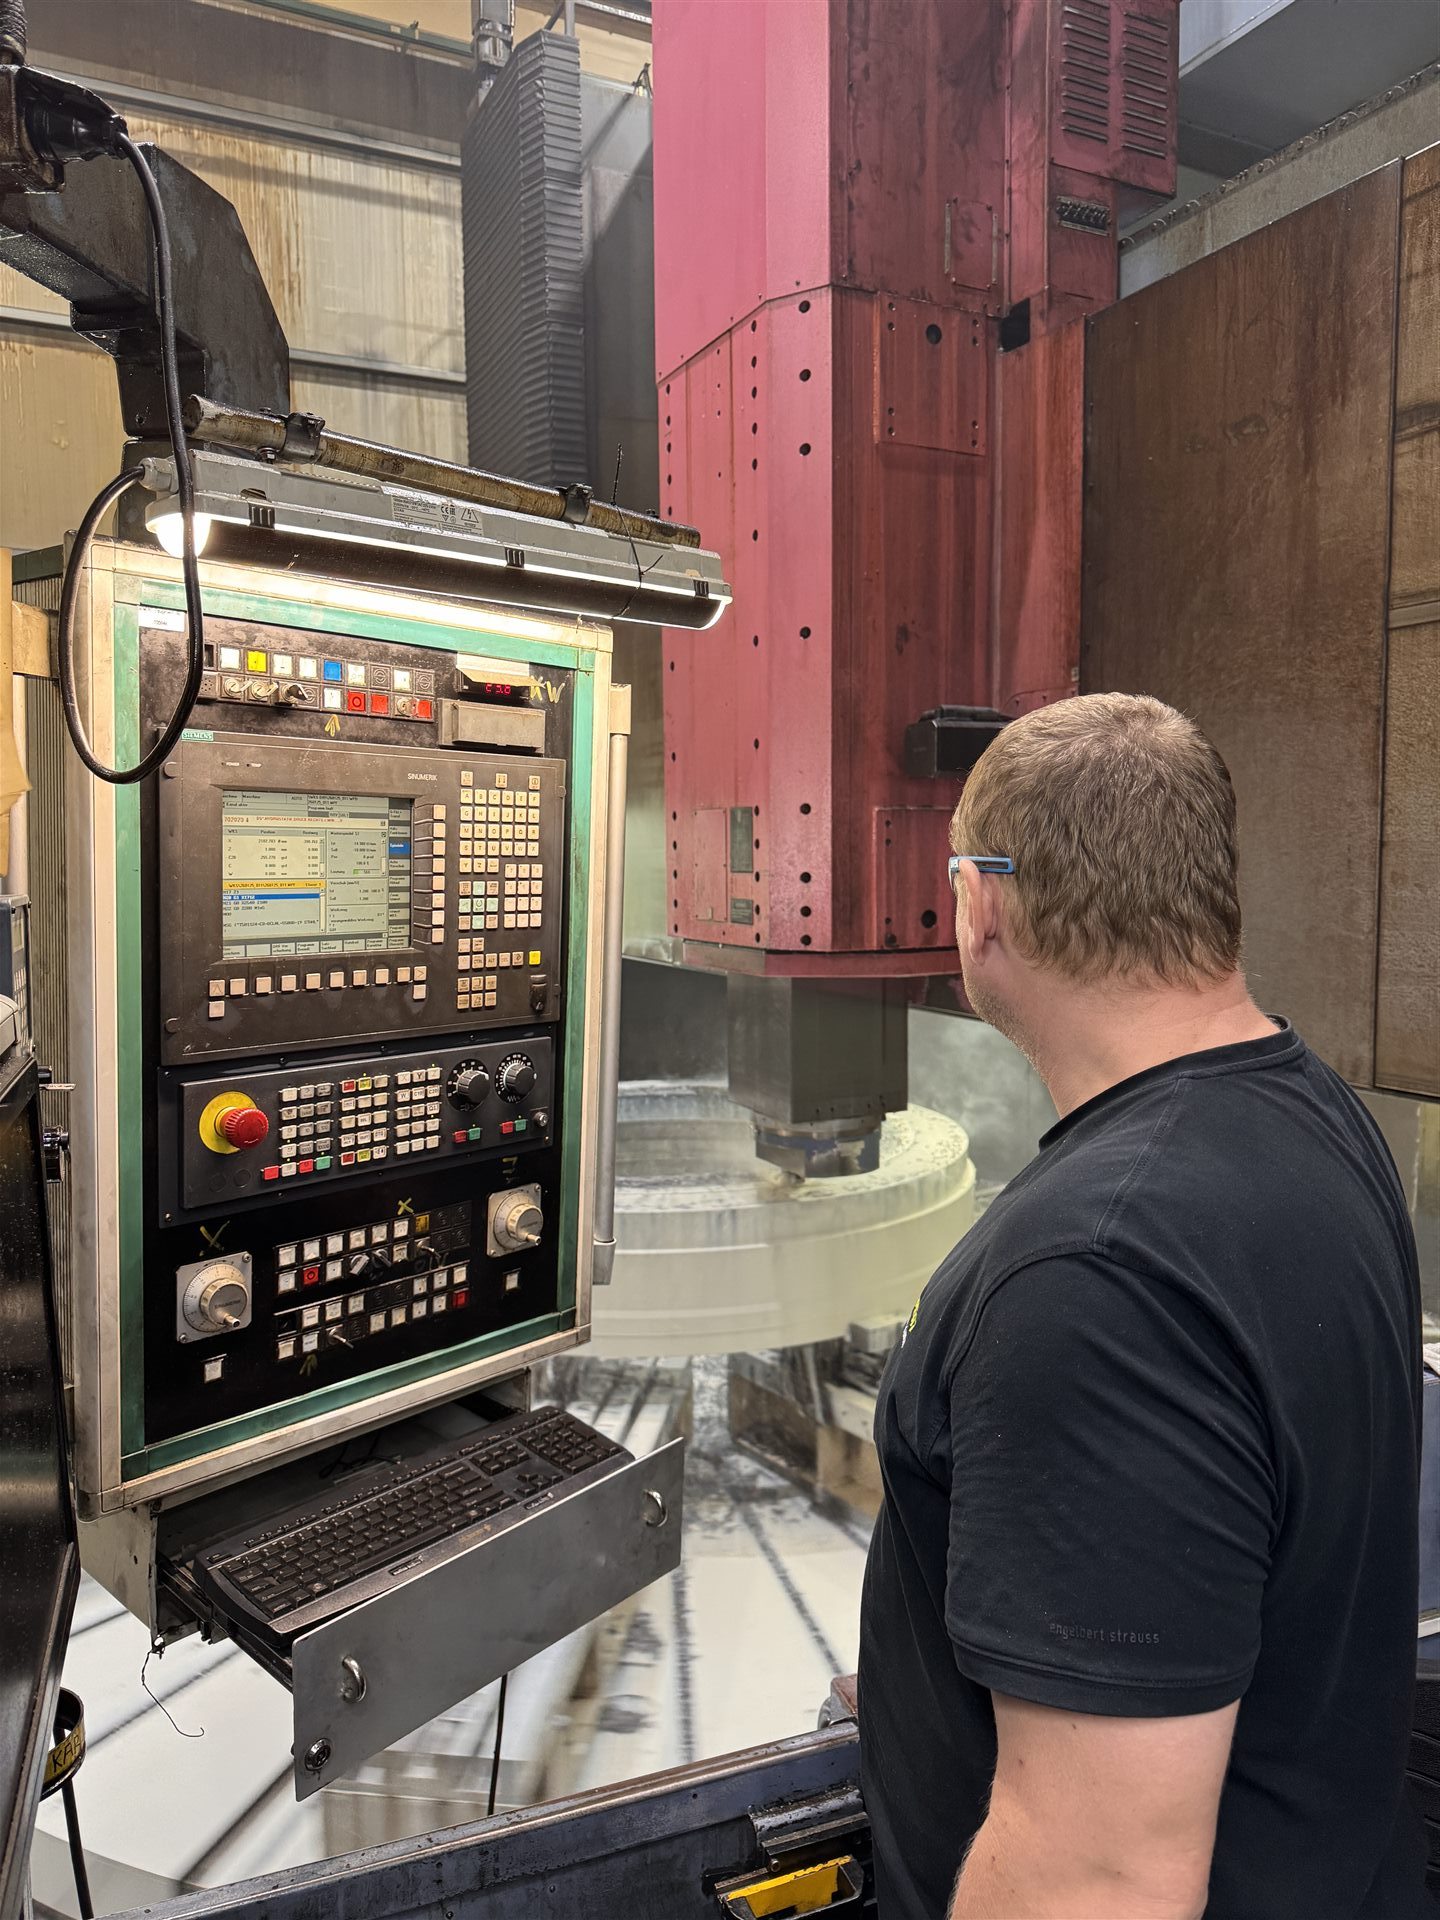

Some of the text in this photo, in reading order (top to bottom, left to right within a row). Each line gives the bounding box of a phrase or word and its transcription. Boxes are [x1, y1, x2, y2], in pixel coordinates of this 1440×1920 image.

[183, 731, 212, 739] SIEMENS
[407, 773, 438, 781] SINUMERIK
[1050, 1623, 1160, 1644] engelbert strauss
